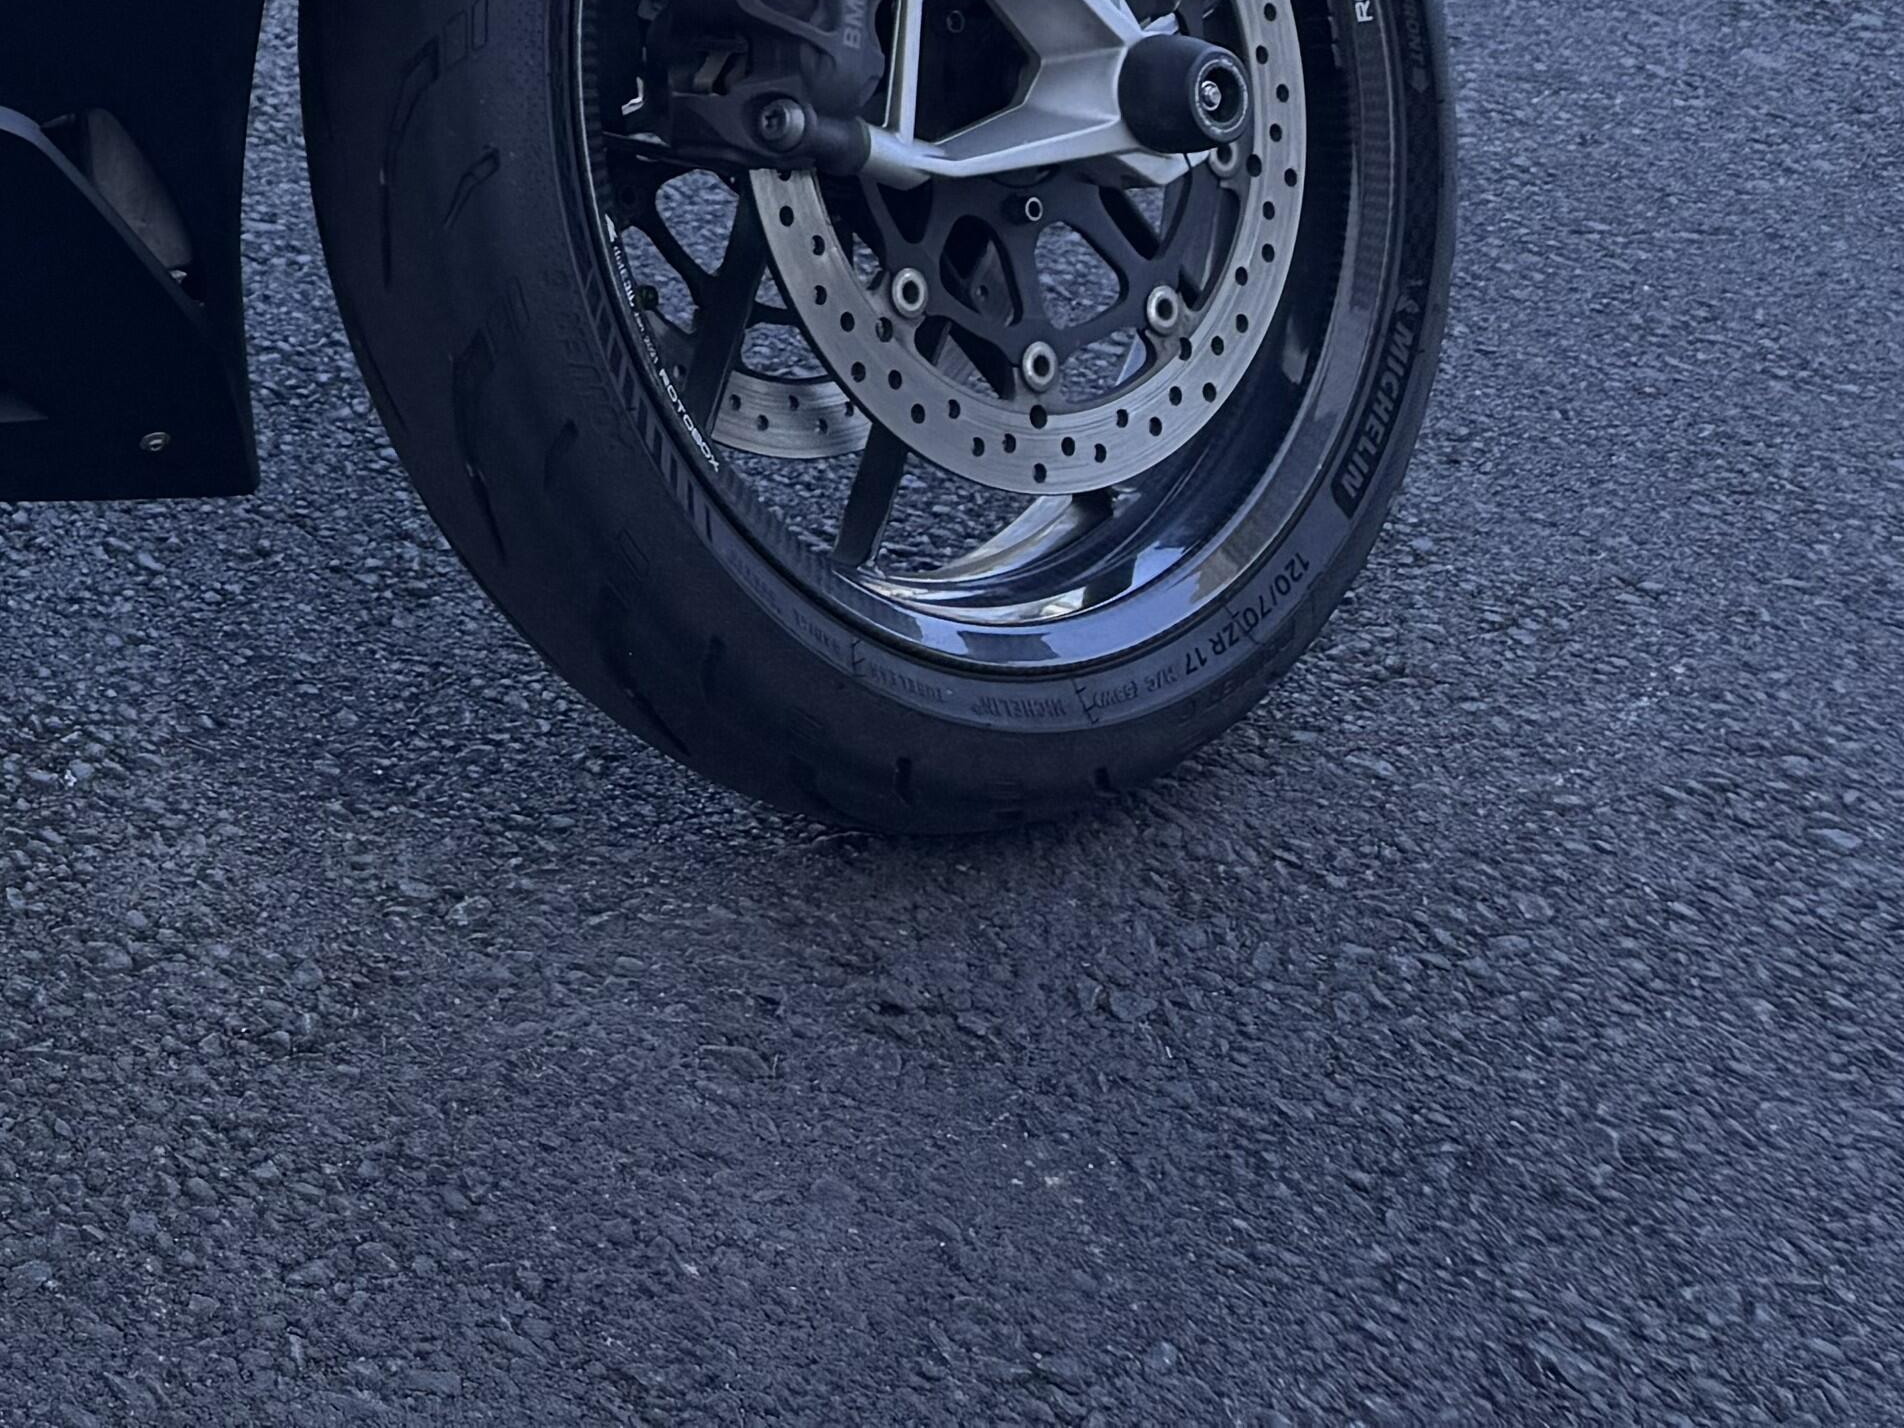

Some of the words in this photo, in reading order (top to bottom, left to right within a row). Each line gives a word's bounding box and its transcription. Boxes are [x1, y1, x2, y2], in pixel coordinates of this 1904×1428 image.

[657, 367, 721, 473] ROTOBOX
[1339, 319, 1417, 500] MICHELIN
[1238, 552, 1313, 631] 120/70
[1184, 646, 1209, 675] 17
[1207, 621, 1241, 656] ZR
[979, 694, 1068, 718] MICHELIN
